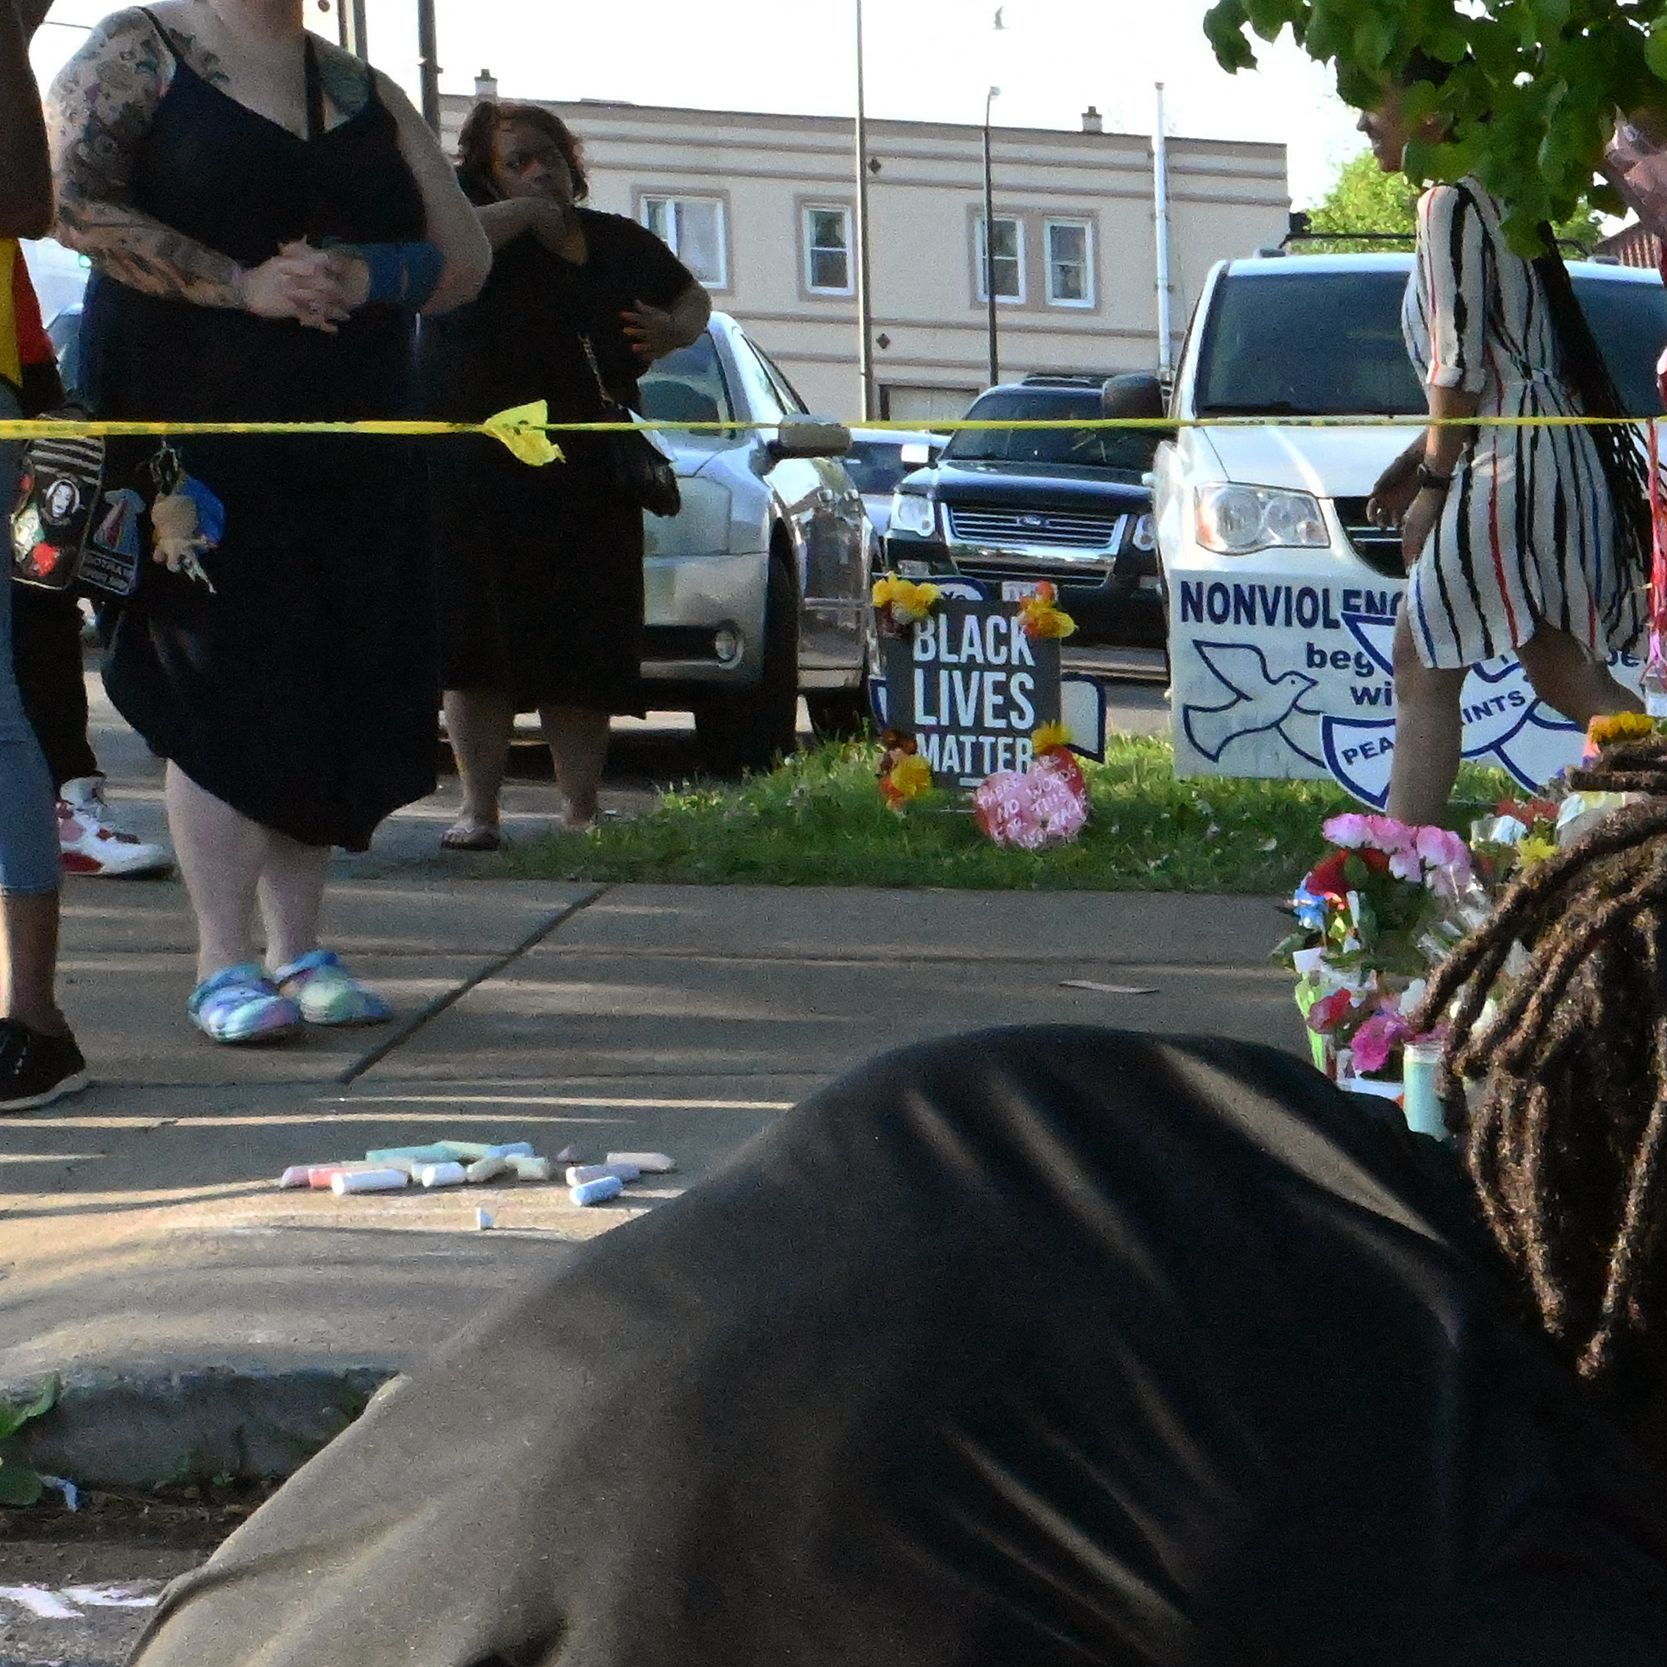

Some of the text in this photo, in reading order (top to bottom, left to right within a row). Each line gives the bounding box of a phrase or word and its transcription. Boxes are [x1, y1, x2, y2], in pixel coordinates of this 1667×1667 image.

[913, 613, 1036, 667] BLACK
[1306, 642, 1376, 677] beg
[914, 668, 1035, 730] LIVES
[915, 732, 1033, 775] MATTER
